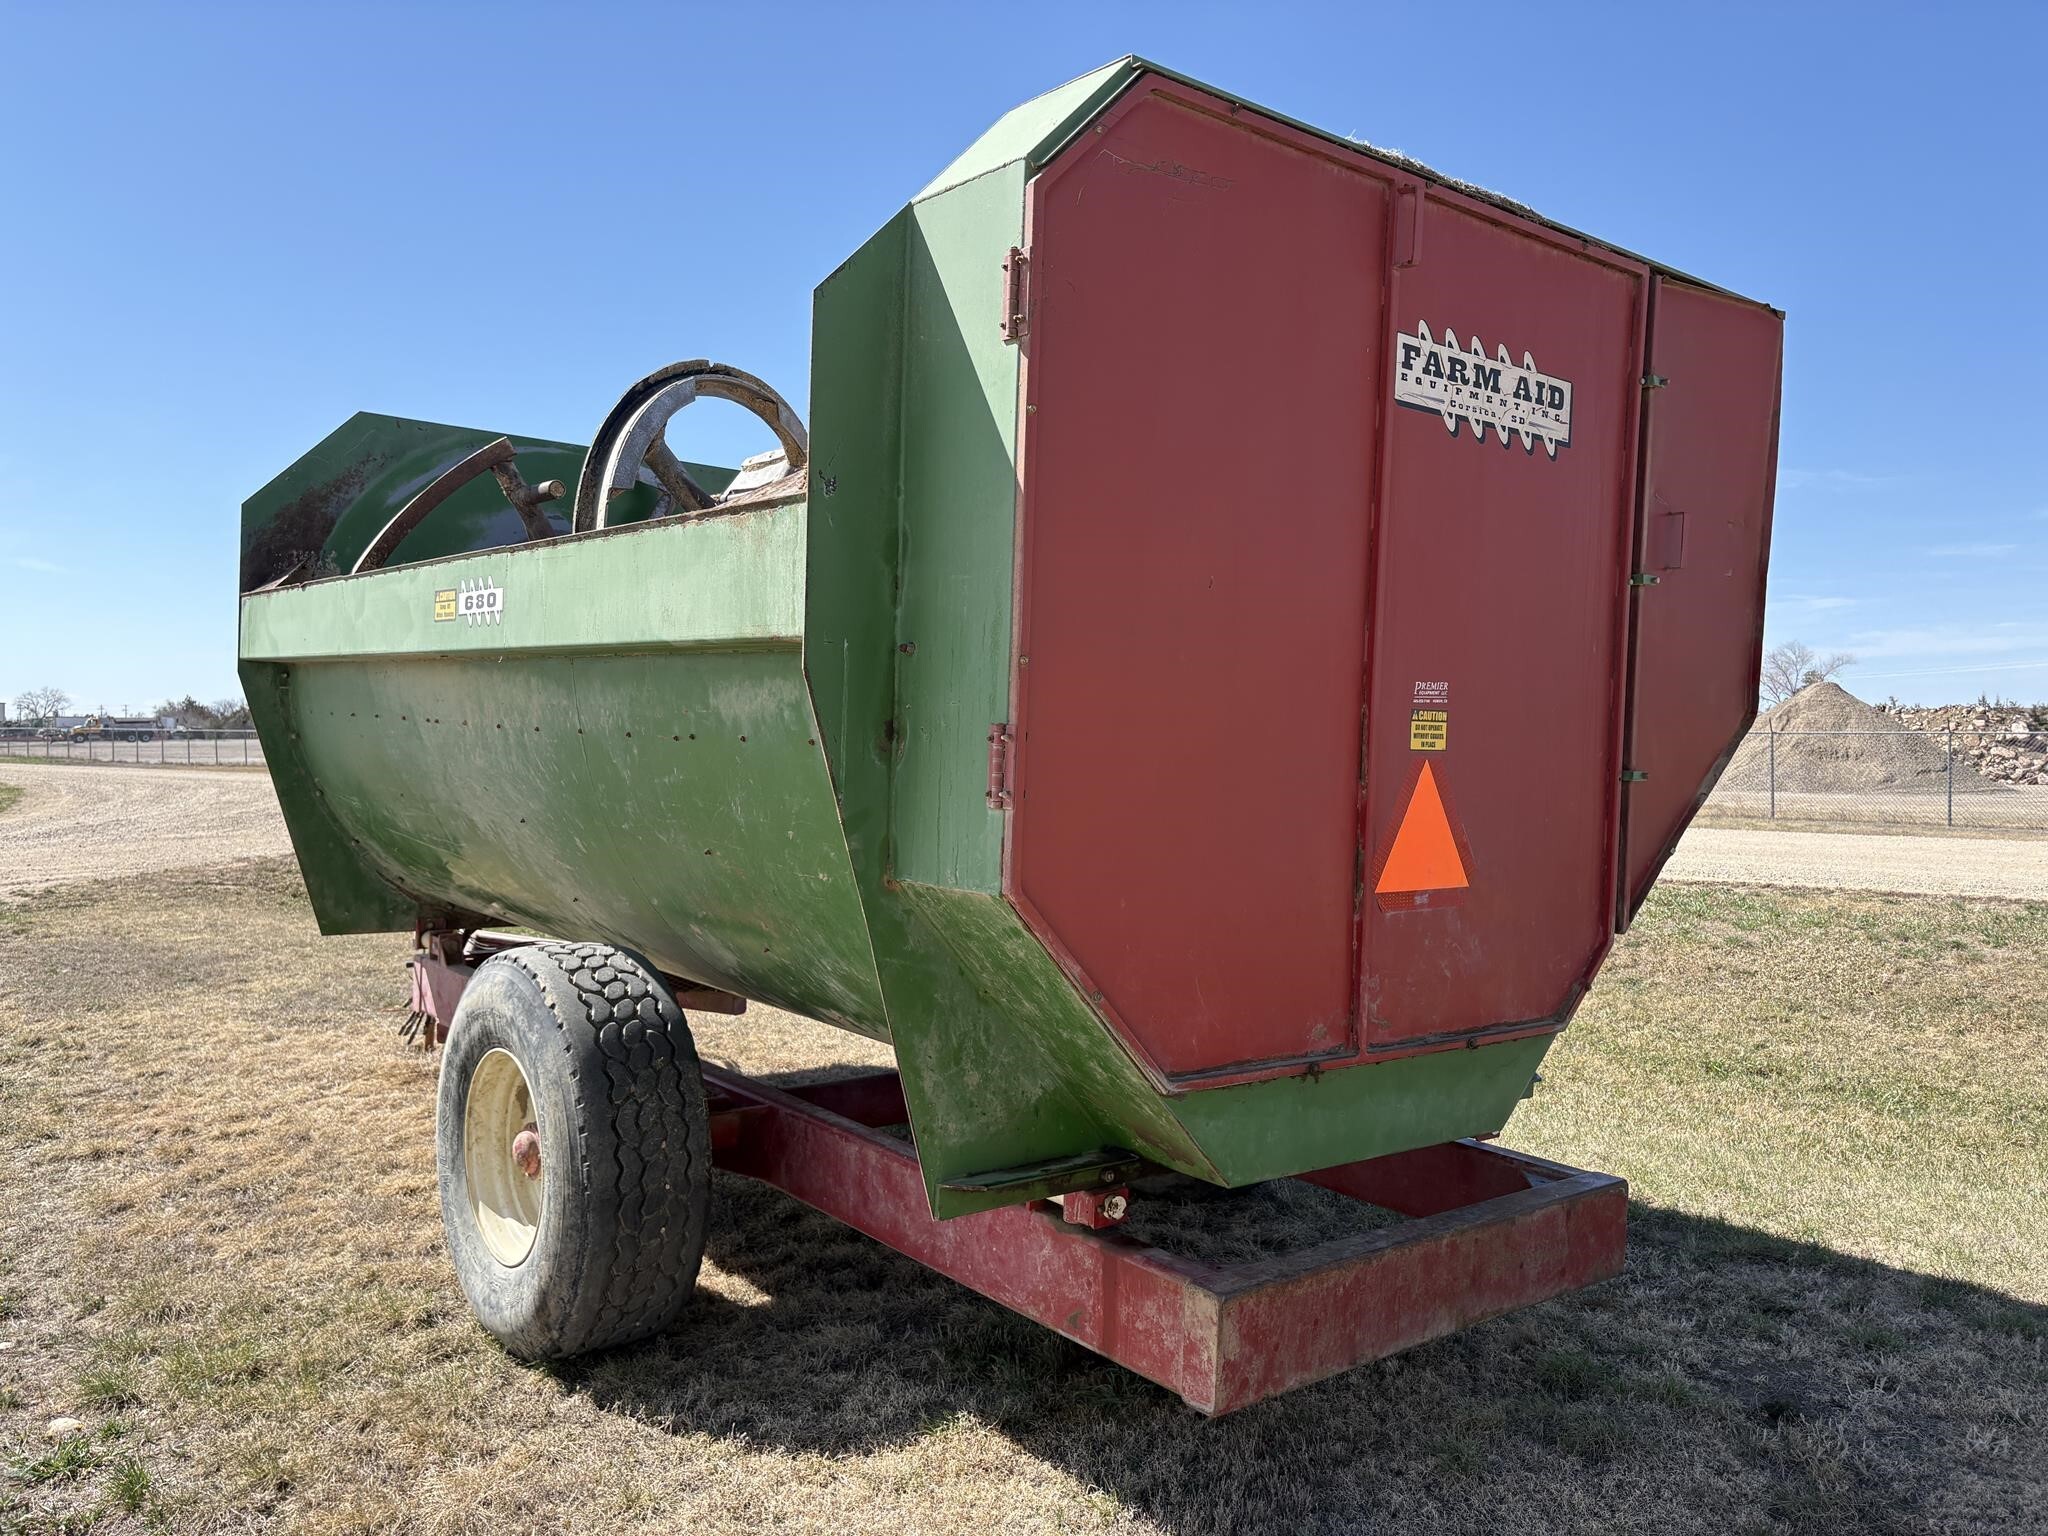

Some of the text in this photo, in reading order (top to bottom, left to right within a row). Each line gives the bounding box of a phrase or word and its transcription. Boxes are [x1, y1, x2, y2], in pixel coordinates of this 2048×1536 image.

[1401, 342, 1565, 411] FARM AID
[1511, 415, 1526, 425] SD
[465, 592, 497, 611] 680
[1414, 681, 1449, 695] PREMIER
[1418, 710, 1448, 721] CAUTION
